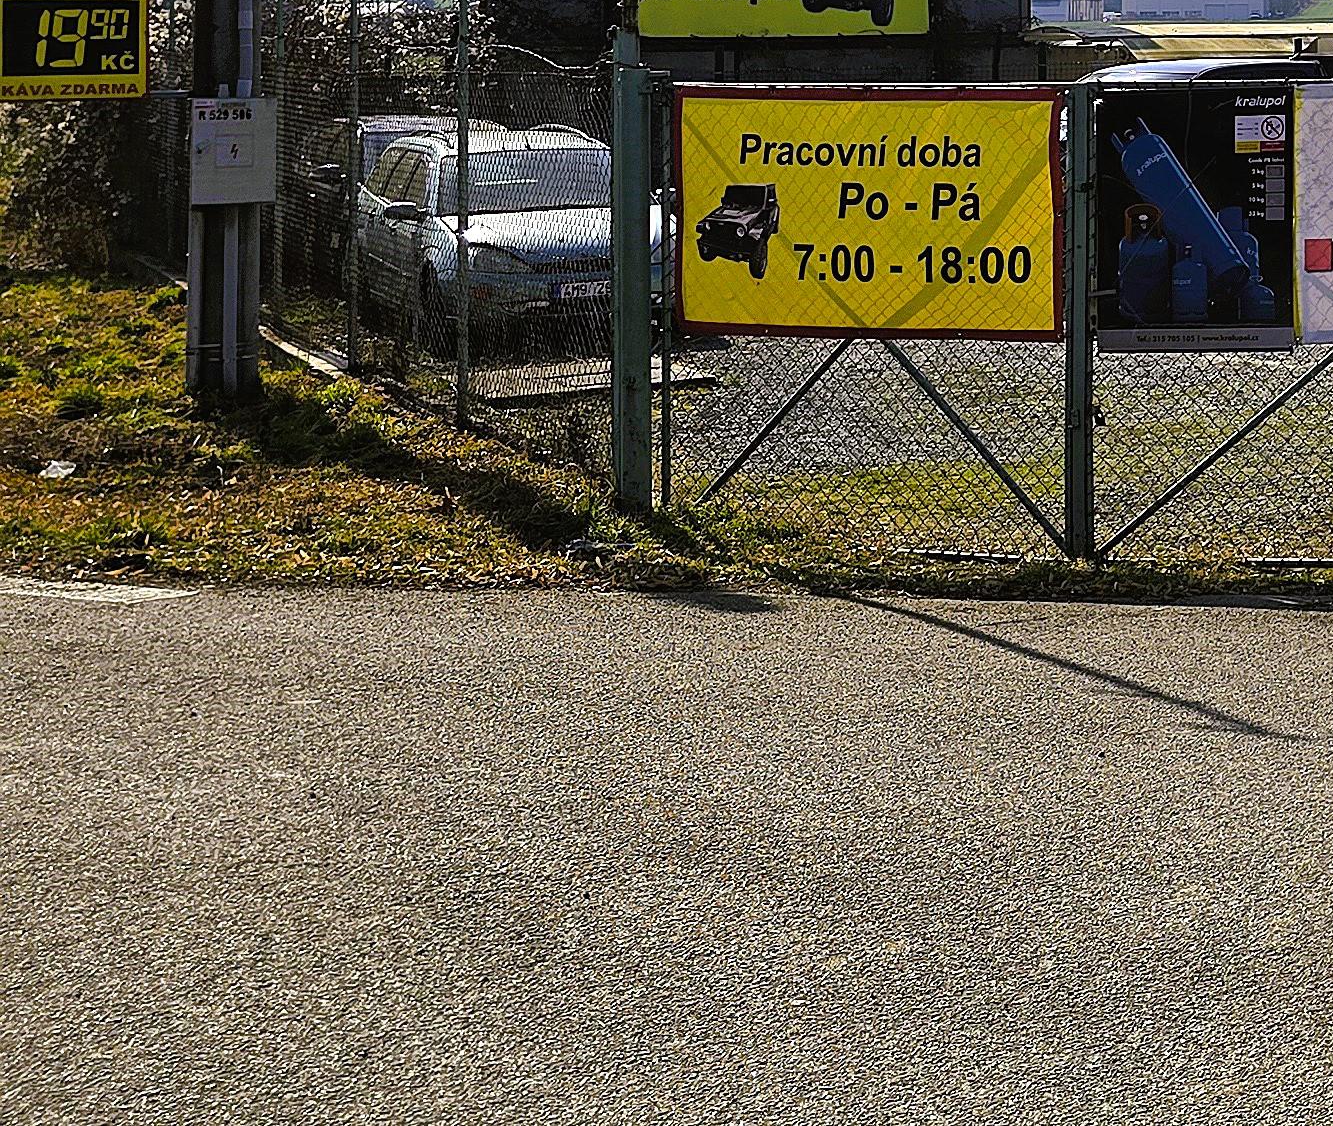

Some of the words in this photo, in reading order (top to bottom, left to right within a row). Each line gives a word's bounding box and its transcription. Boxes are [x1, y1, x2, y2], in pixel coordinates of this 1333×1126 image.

[100, 50, 135, 71] KČ
[1, 83, 54, 96] KÁVA
[60, 83, 139, 95] ZDARMA
[1235, 95, 1286, 108] kralupol
[739, 133, 888, 167] Pracovní
[896, 135, 982, 168] doba
[838, 182, 889, 220] Po
[931, 182, 981, 221] Pá
[793, 244, 875, 282] 7:00
[917, 245, 1032, 284] 18:00
